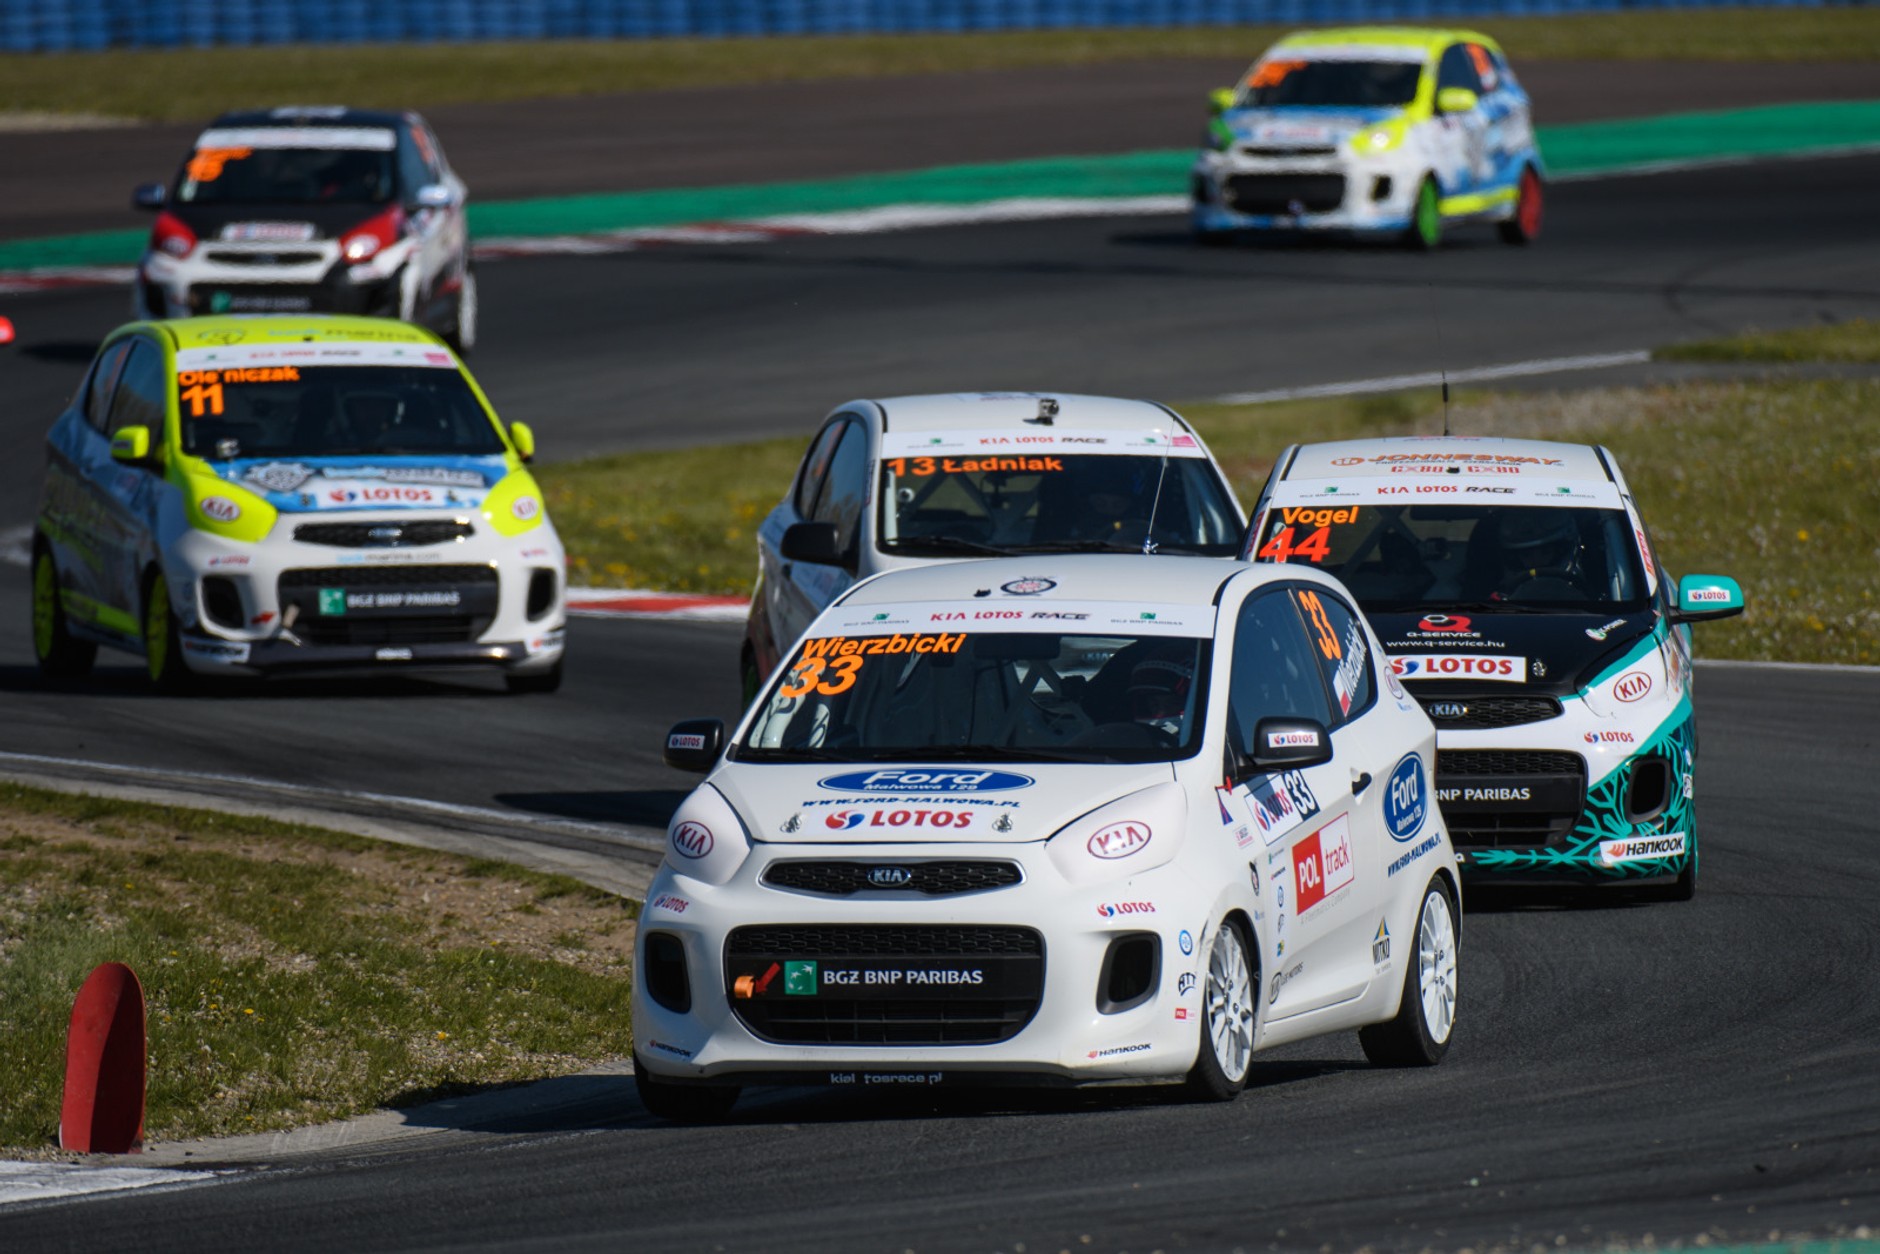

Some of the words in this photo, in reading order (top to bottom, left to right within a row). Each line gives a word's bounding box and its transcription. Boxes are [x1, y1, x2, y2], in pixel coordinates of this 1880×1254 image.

[181, 383, 225, 417] 11
[980, 437, 1010, 445] KIA
[1015, 436, 1055, 444] LOTOS
[1368, 453, 1562, 465] JONNESWAY
[887, 457, 936, 478] 13
[943, 456, 1064, 473] Ładniak
[364, 488, 434, 501] LOTOS
[1377, 486, 1409, 495] KIA
[1416, 485, 1458, 493] LOTOS
[1464, 486, 1517, 494] RACE
[1282, 505, 1359, 528] Vogel
[1258, 527, 1331, 563] 44
[1703, 591, 1727, 600] LOTOS
[930, 612, 966, 621] KIA
[974, 611, 1023, 620] LOTOS
[1029, 612, 1090, 620] RACE
[1298, 590, 1342, 660] 33
[803, 633, 967, 659] Wierzbicki
[1386, 640, 1506, 648] www.q-service.hu
[1426, 658, 1512, 675] LOTOS
[780, 655, 864, 698] 33
[1619, 676, 1648, 699] KIA
[1436, 704, 1461, 716] KIA
[680, 736, 701, 747] LOTOS
[1286, 734, 1314, 744] LOTOS
[1600, 731, 1635, 743] LOTOS
[862, 771, 994, 785] Ford
[1284, 768, 1316, 815] 33
[1391, 762, 1418, 817] Ford
[1464, 788, 1531, 800] PARIBAS
[870, 810, 974, 829] LOTOS
[677, 827, 705, 854] KIA
[1095, 825, 1144, 855] KIA
[1298, 854, 1321, 894] POL
[1325, 835, 1350, 876] track
[873, 869, 903, 882] KIA
[1115, 902, 1155, 914] LOTOS
[864, 970, 902, 984] BNP
[906, 970, 984, 984] PARIBAS
